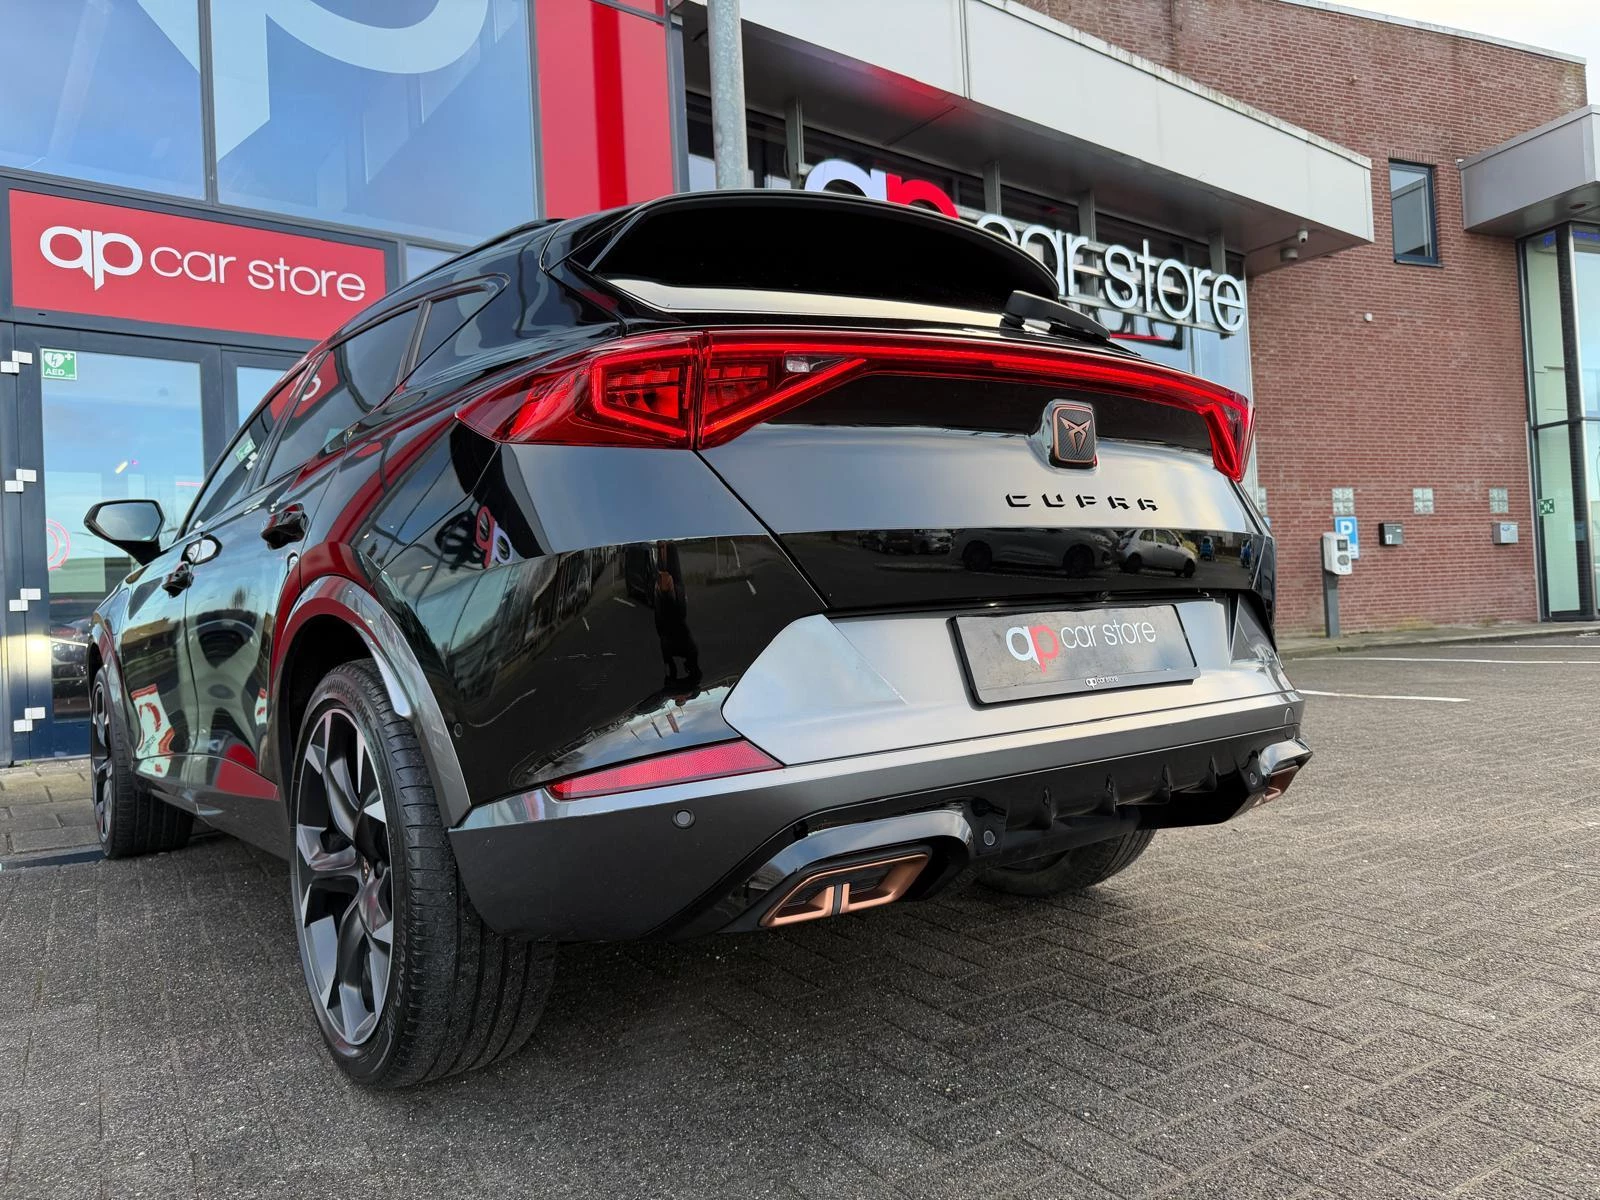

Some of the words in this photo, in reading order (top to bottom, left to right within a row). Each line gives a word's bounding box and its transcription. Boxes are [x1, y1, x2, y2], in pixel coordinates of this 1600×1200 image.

[40, 225, 143, 291] ap
[150, 247, 236, 284] car
[247, 257, 366, 302] store
[1104, 238, 1245, 333] store
[45, 368, 65, 376] AED
[1005, 493, 1159, 512] CUPRA
[1006, 624, 1060, 674] ap
[1060, 624, 1098, 649] car
[1102, 619, 1157, 646] store
